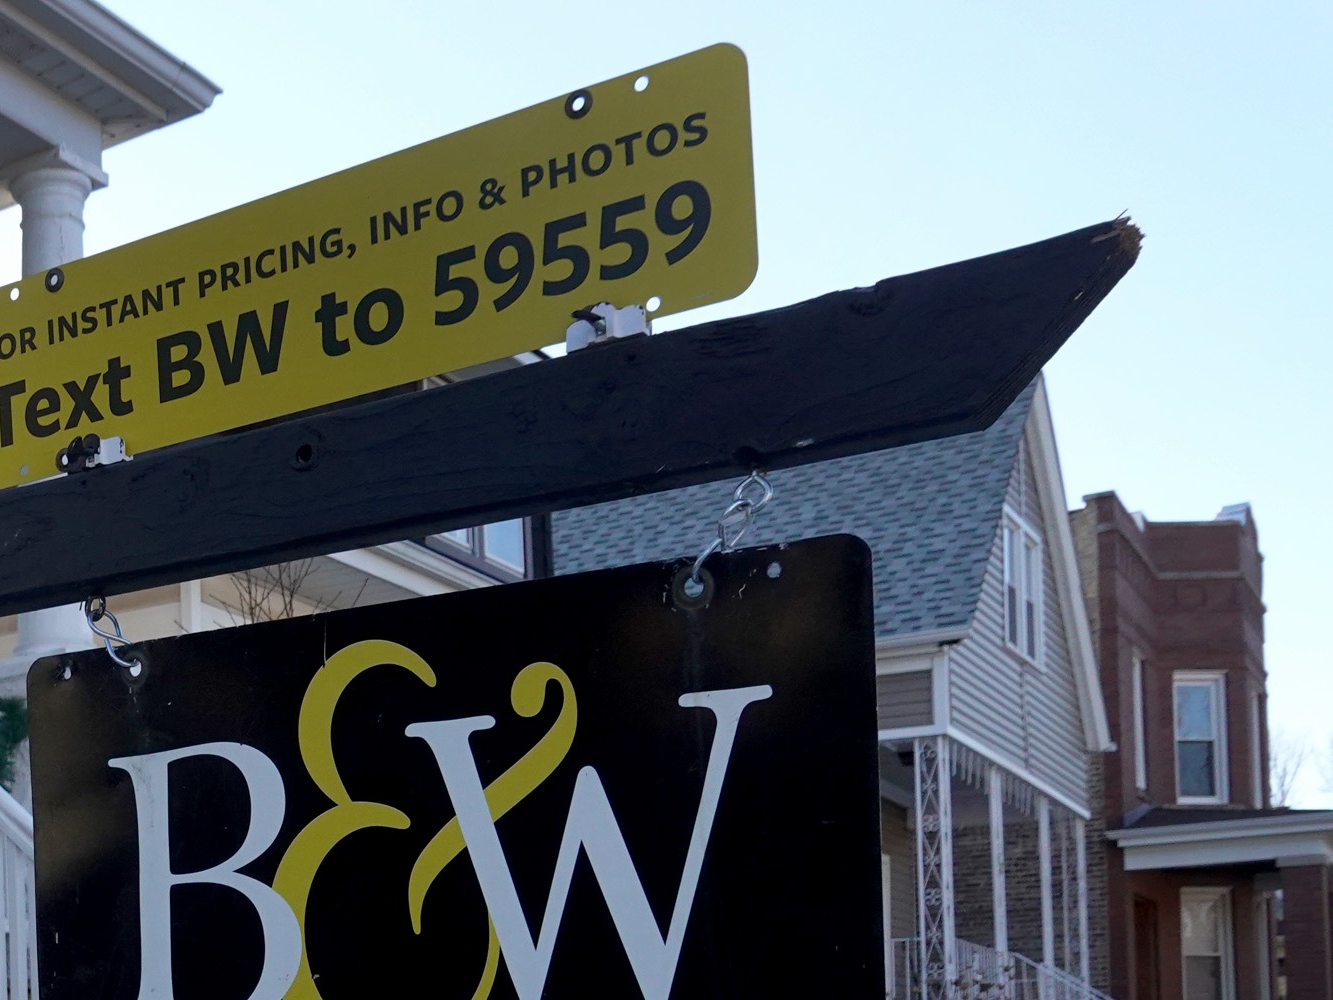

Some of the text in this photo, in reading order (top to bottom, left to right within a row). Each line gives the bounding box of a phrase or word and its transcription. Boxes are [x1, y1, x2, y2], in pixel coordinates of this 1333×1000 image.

[47, 277, 186, 346] INSTANT
[197, 228, 357, 300] PRICING,
[369, 190, 464, 246] INFO
[478, 177, 508, 211] &
[520, 112, 709, 199] PHOTOS
[156, 299, 290, 405] BW
[314, 287, 405, 358] to
[434, 180, 712, 327] 59559
